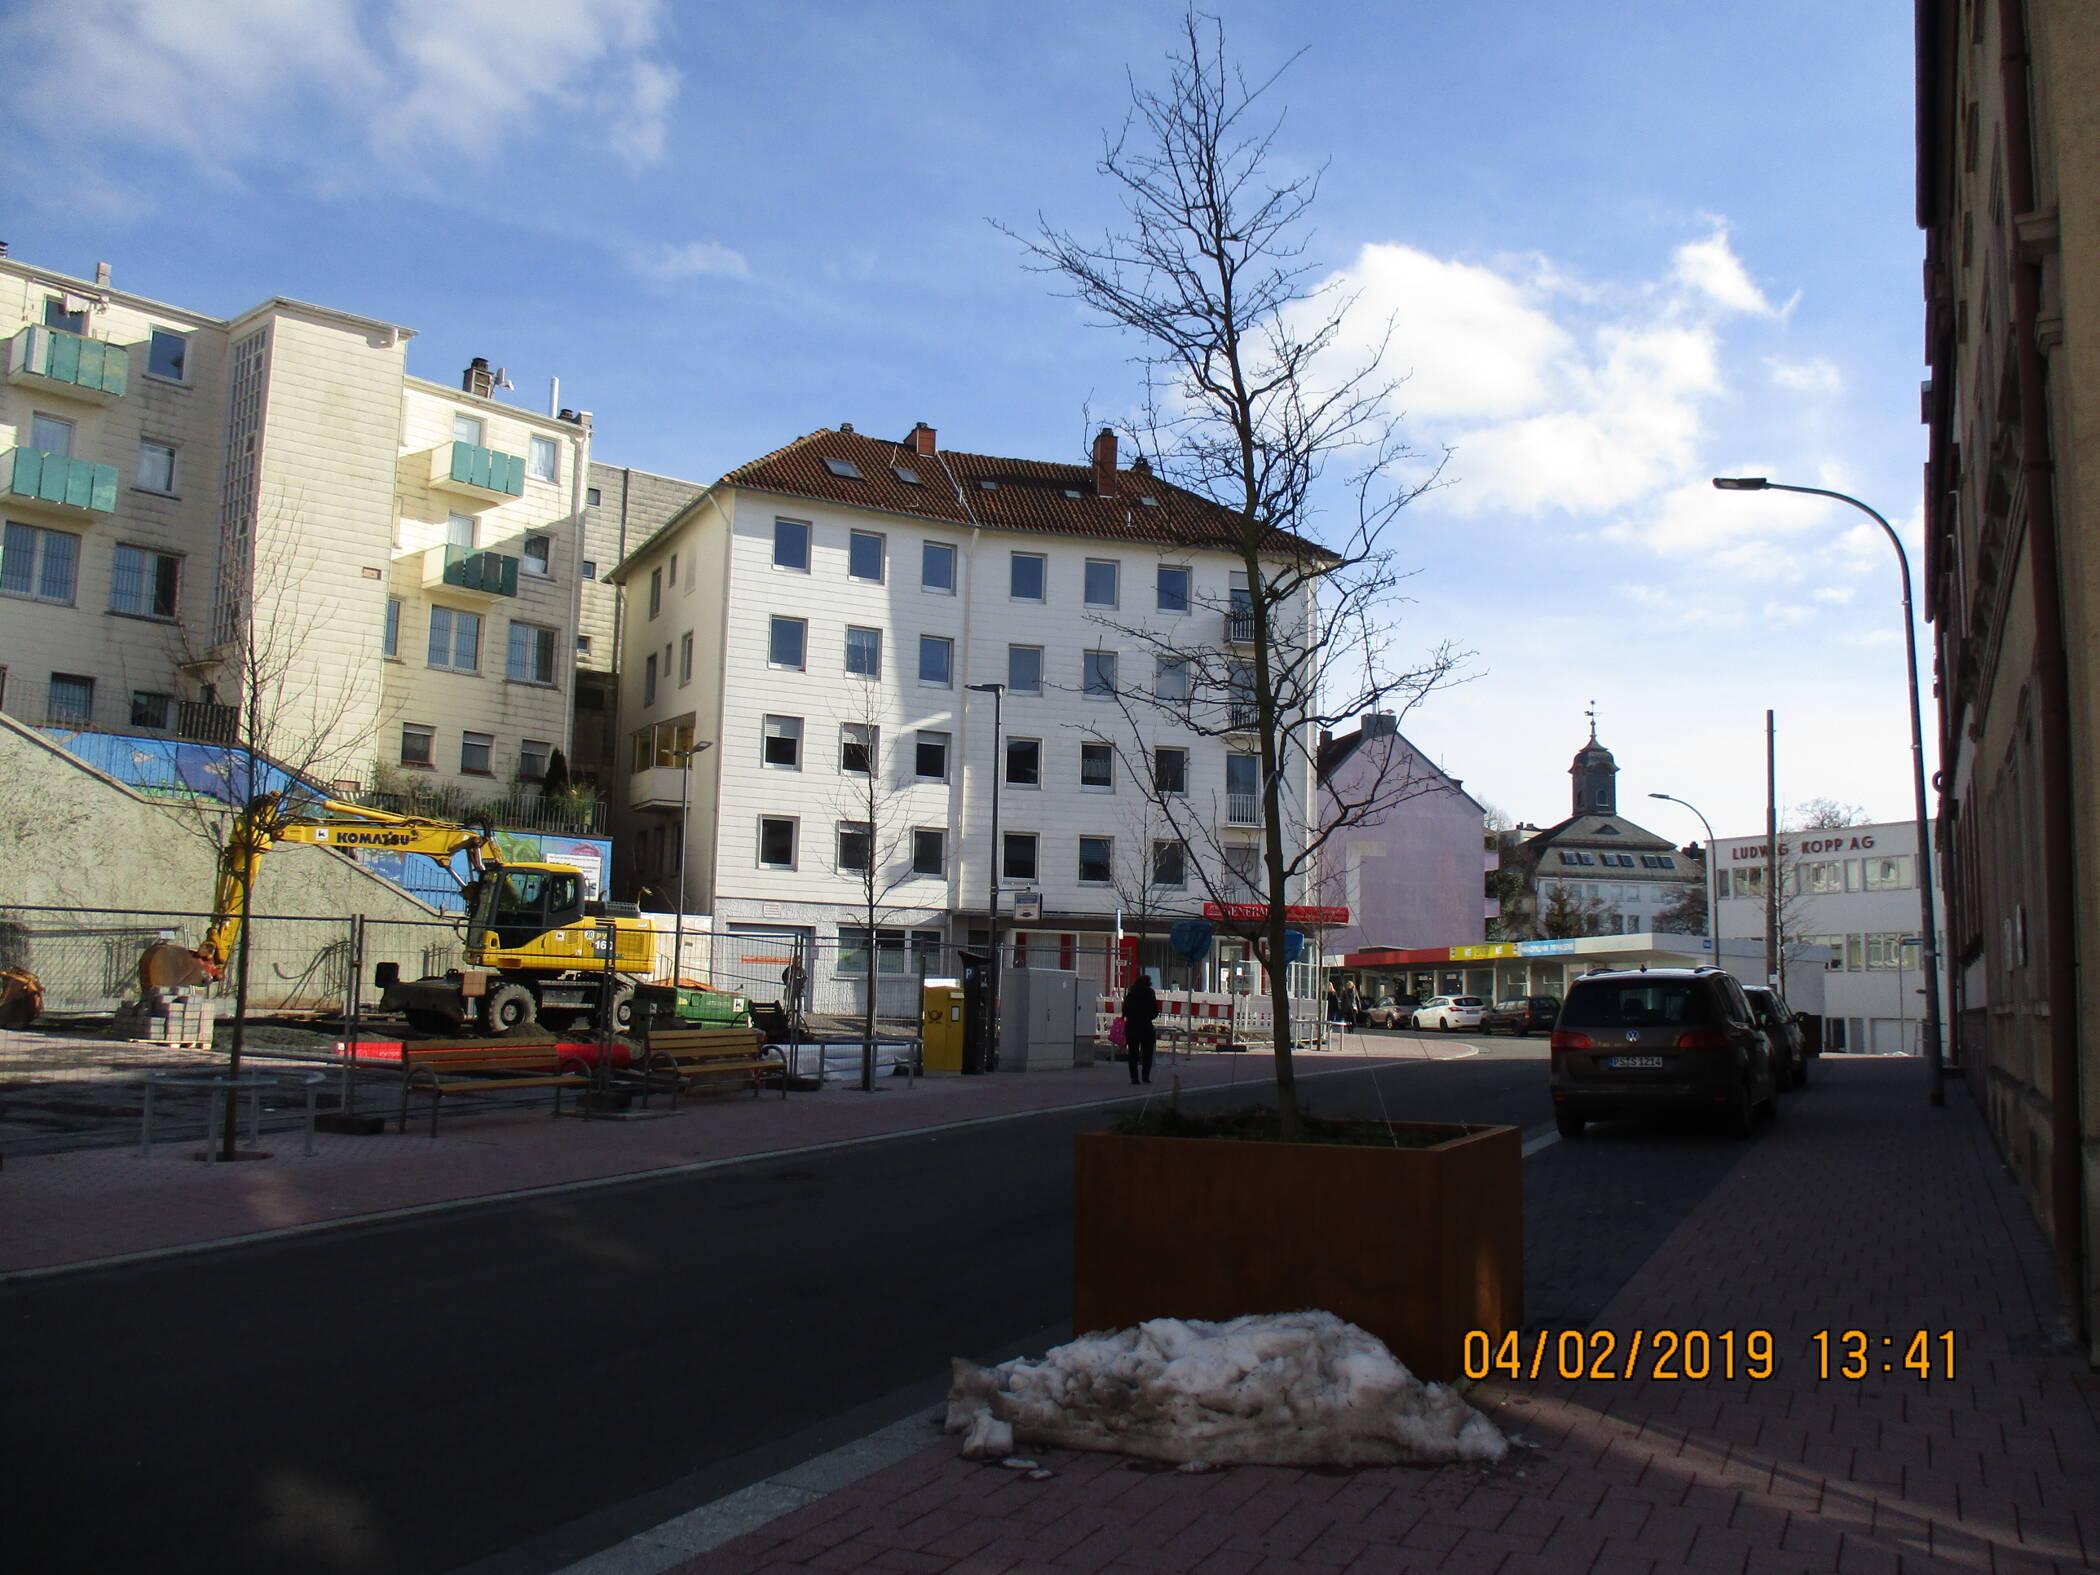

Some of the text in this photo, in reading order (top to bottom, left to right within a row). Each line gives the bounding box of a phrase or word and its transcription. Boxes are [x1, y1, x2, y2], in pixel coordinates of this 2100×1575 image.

[336, 831, 411, 846] KOMATSU
[1732, 835, 1875, 860] LUDWG KOPP AG
